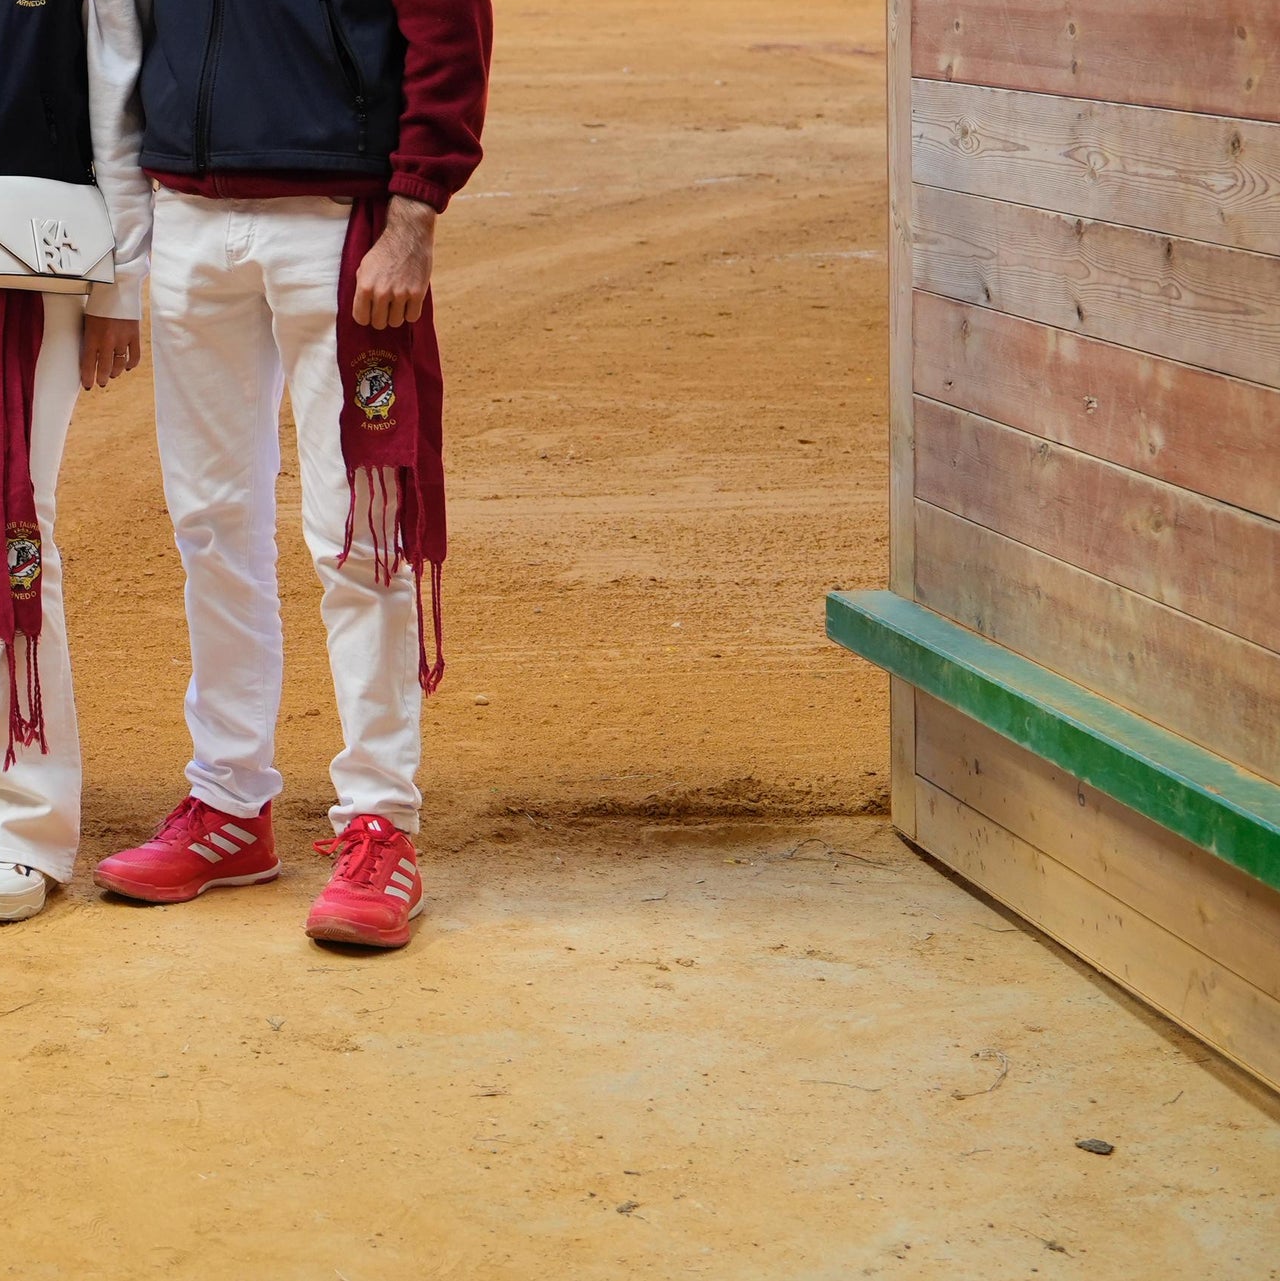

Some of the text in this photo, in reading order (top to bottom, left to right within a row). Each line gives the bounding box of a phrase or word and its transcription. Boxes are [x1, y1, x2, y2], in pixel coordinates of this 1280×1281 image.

[350, 349, 398, 368] CLUB TAURINO
[361, 419, 397, 431] ARNEDO
